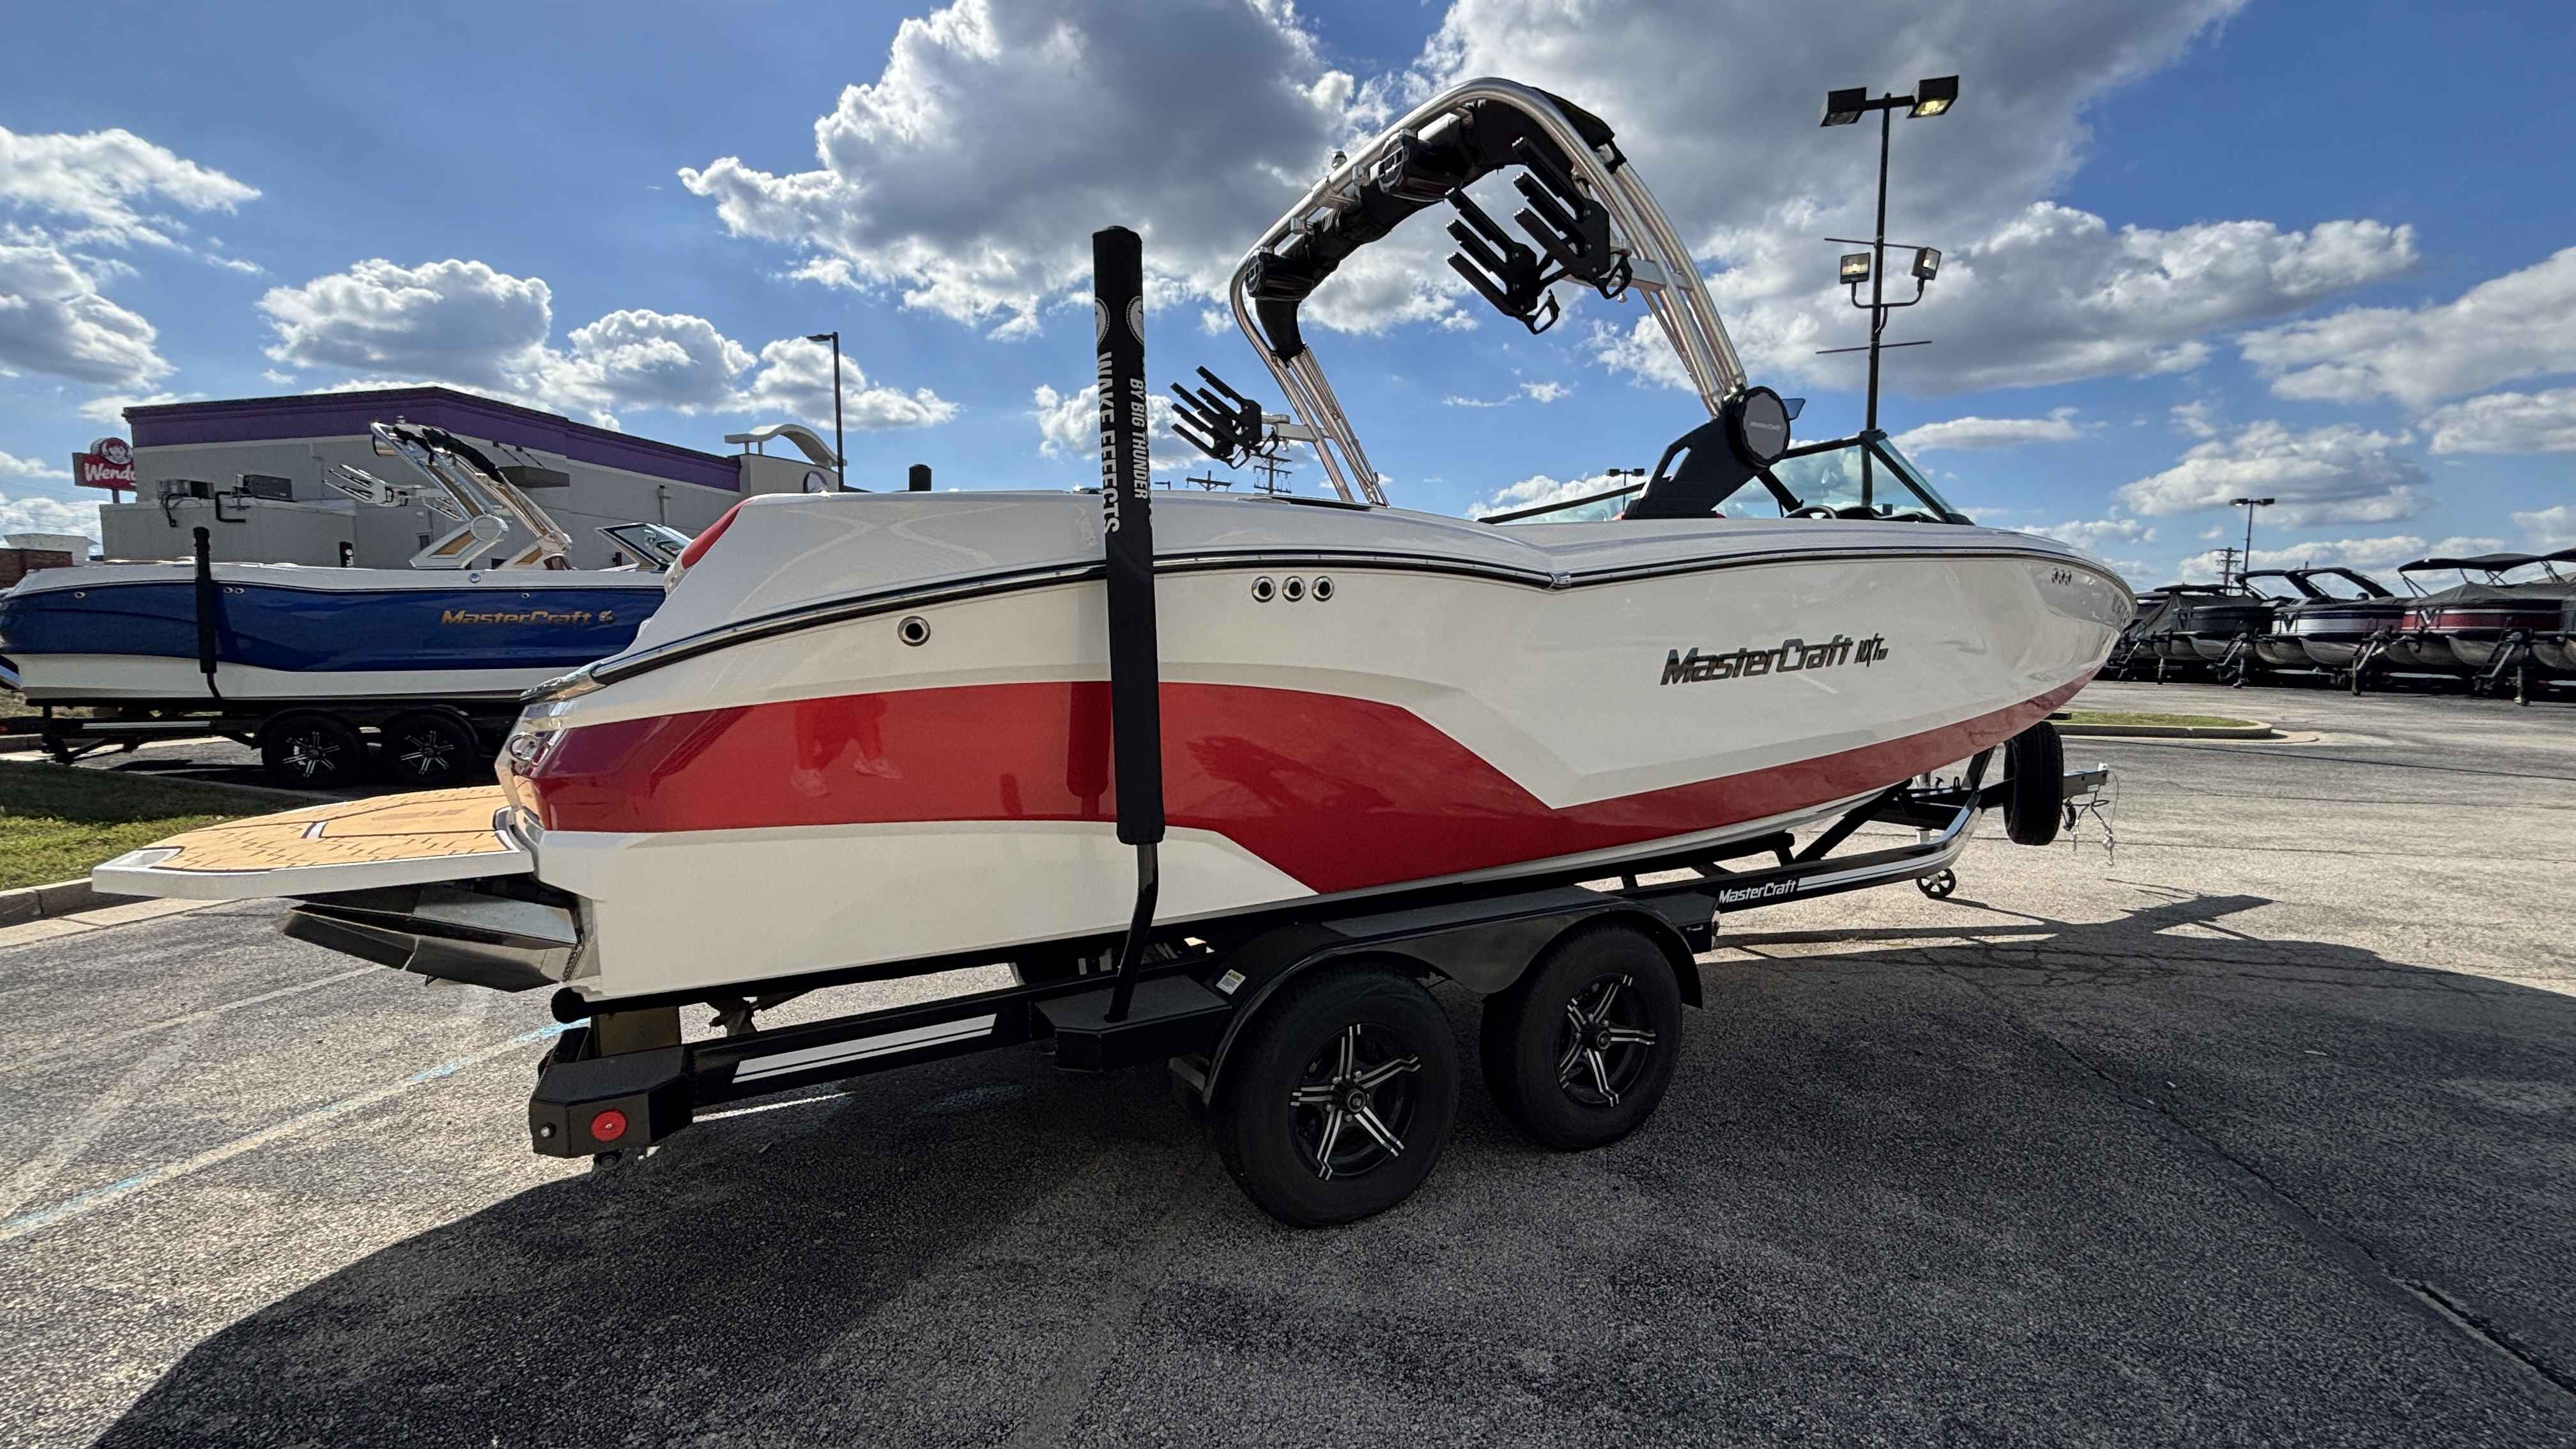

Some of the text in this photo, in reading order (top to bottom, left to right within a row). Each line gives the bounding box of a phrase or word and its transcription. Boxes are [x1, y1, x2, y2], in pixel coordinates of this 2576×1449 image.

[1098, 351, 1120, 533] WAKE EFFECTS
[1130, 378, 1149, 500] BY BIG THUNDER
[441, 610, 592, 624] MasterCraft
[1660, 634, 1853, 686] MasterCraft
[1719, 880, 1797, 904] MasterCraft
